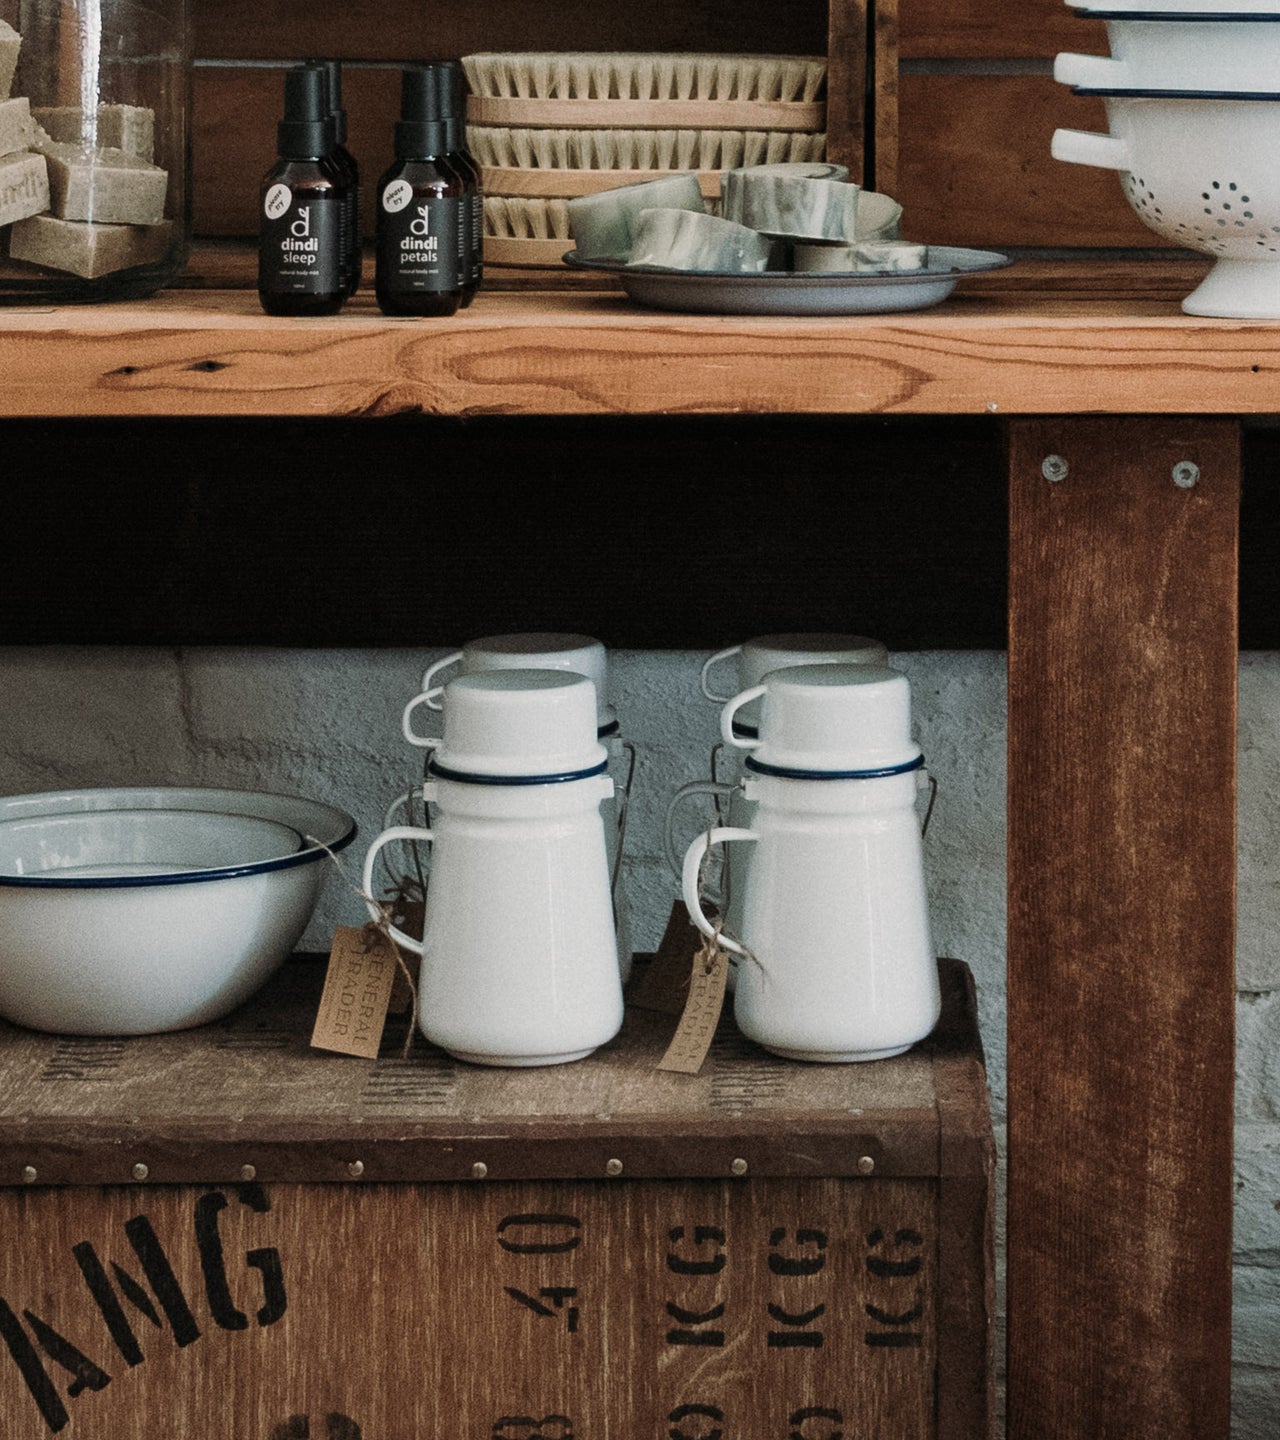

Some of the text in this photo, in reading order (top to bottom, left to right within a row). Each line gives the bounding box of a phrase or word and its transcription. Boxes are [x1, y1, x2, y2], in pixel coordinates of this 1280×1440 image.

[386, 186, 404, 203] please
[393, 198, 403, 206] try
[281, 238, 318, 251] dindi
[400, 236, 438, 250] dindi
[283, 252, 316, 265] sleep
[400, 251, 438, 264] petals
[332, 946, 365, 1036] TRADER
[666, 1226, 725, 1347] KG
[768, 1227, 828, 1347] KG
[865, 1228, 922, 1347] KG
